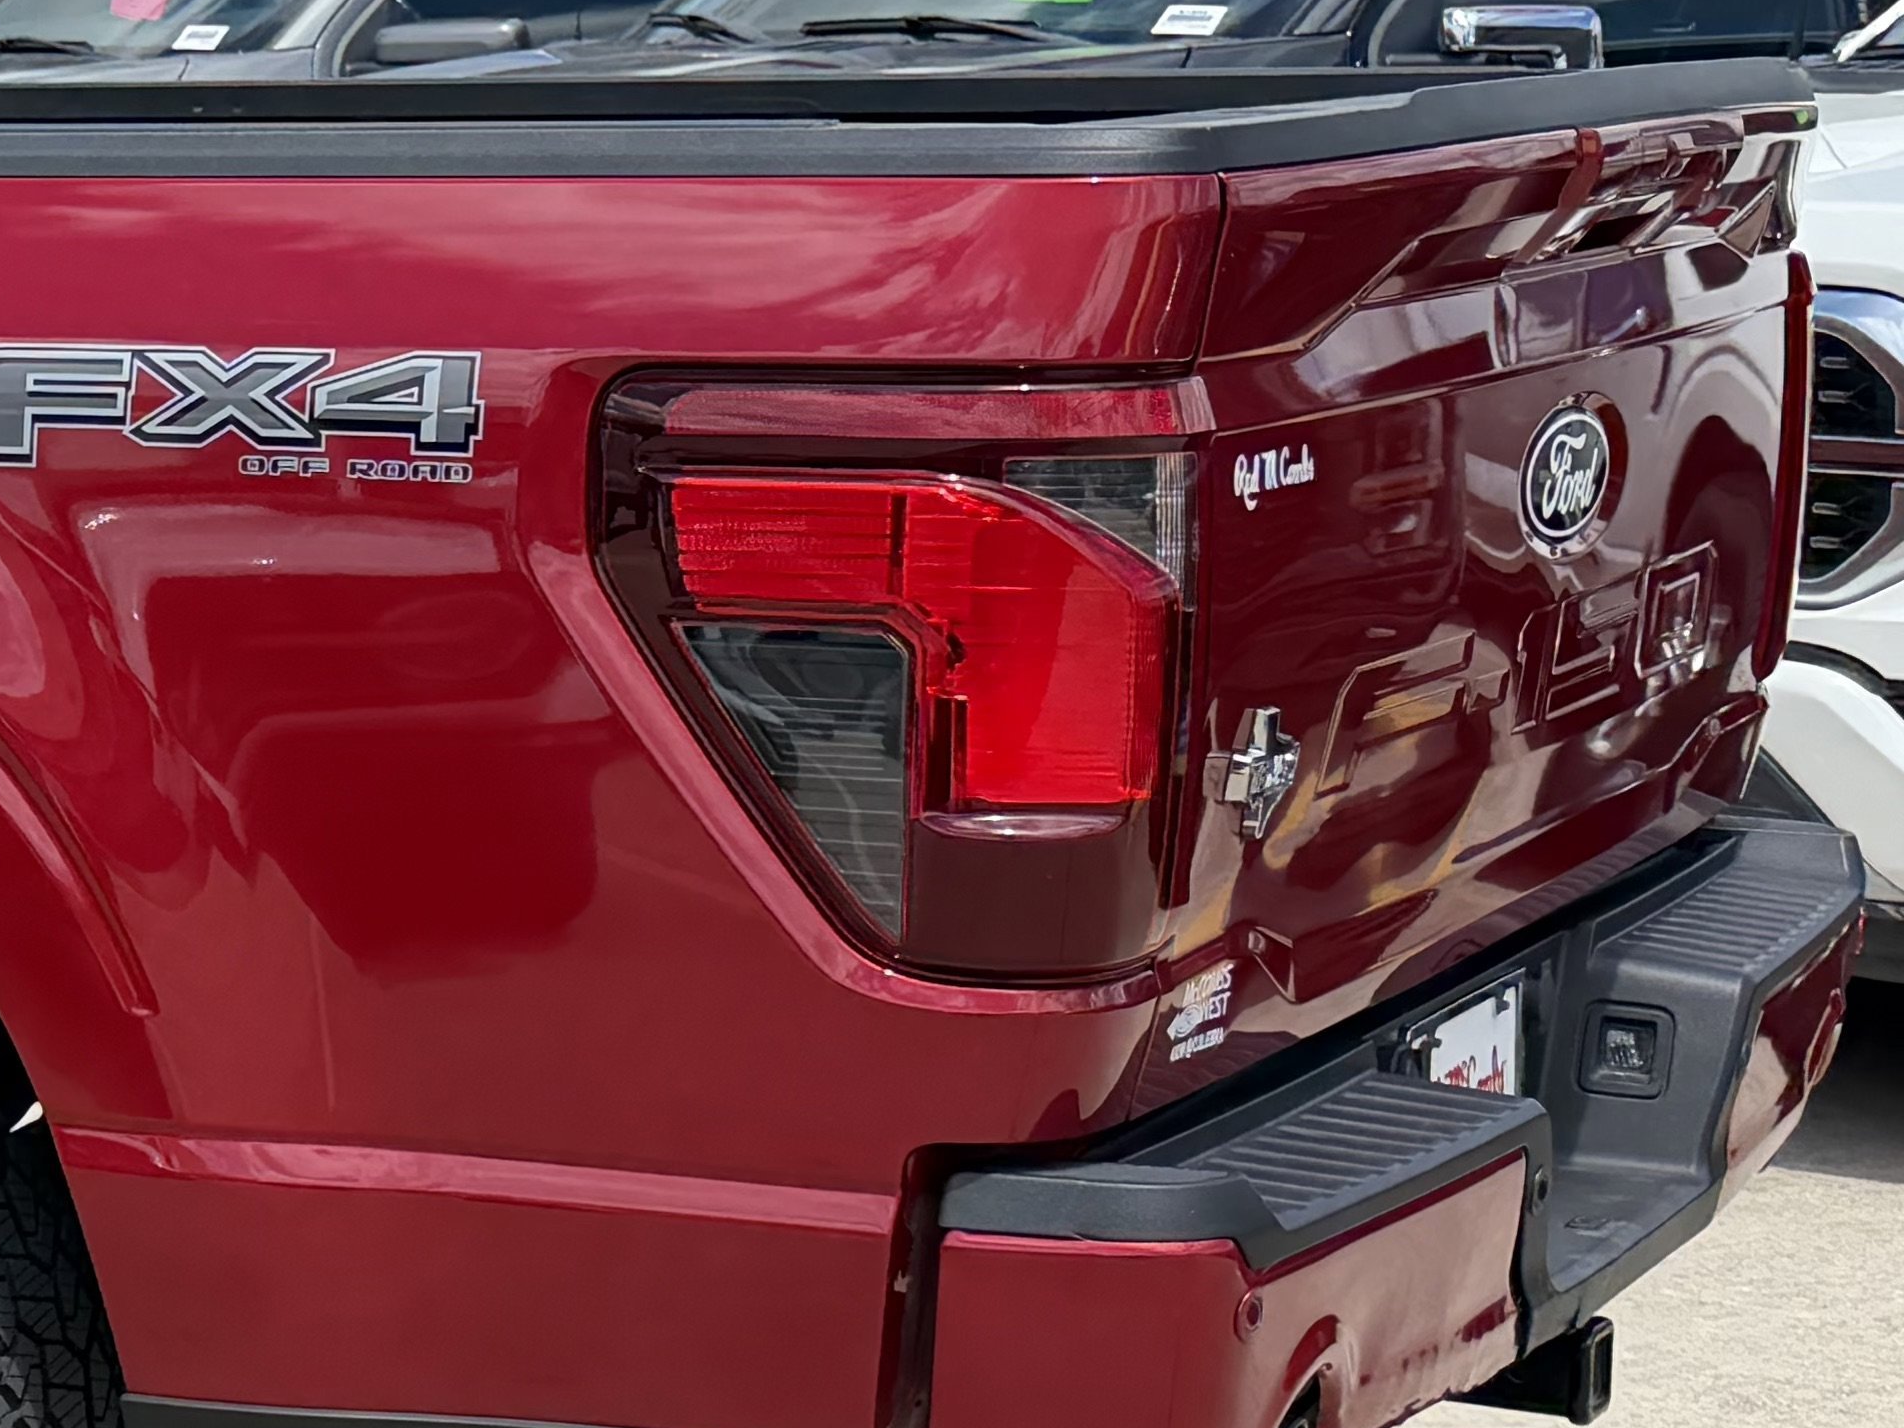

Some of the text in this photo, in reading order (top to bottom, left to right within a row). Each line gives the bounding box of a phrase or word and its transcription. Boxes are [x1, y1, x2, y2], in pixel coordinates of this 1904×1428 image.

[237, 455, 473, 484] OFF ROAD
[1542, 432, 1599, 520] Ford
